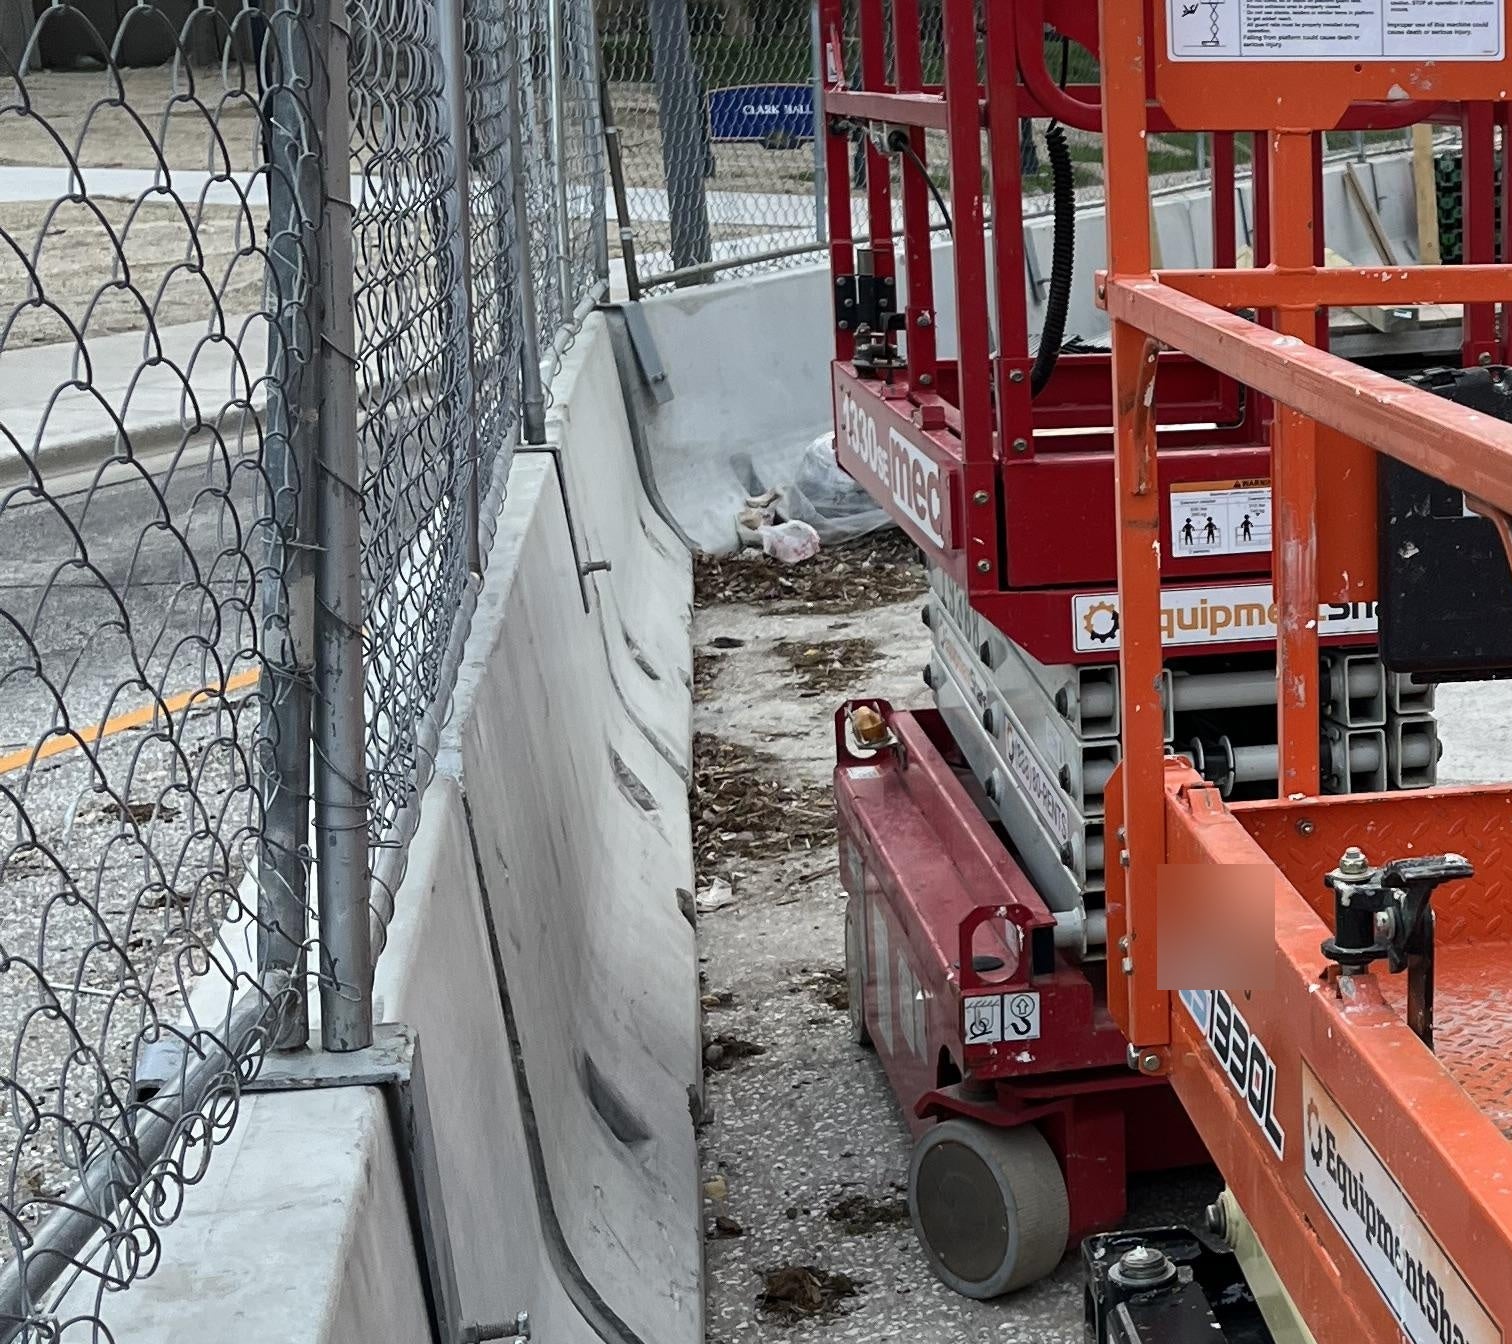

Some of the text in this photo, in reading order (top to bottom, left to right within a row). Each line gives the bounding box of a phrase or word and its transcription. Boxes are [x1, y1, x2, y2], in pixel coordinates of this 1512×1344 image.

[742, 104, 813, 115] CLARK HALL
[890, 436, 943, 536] mec
